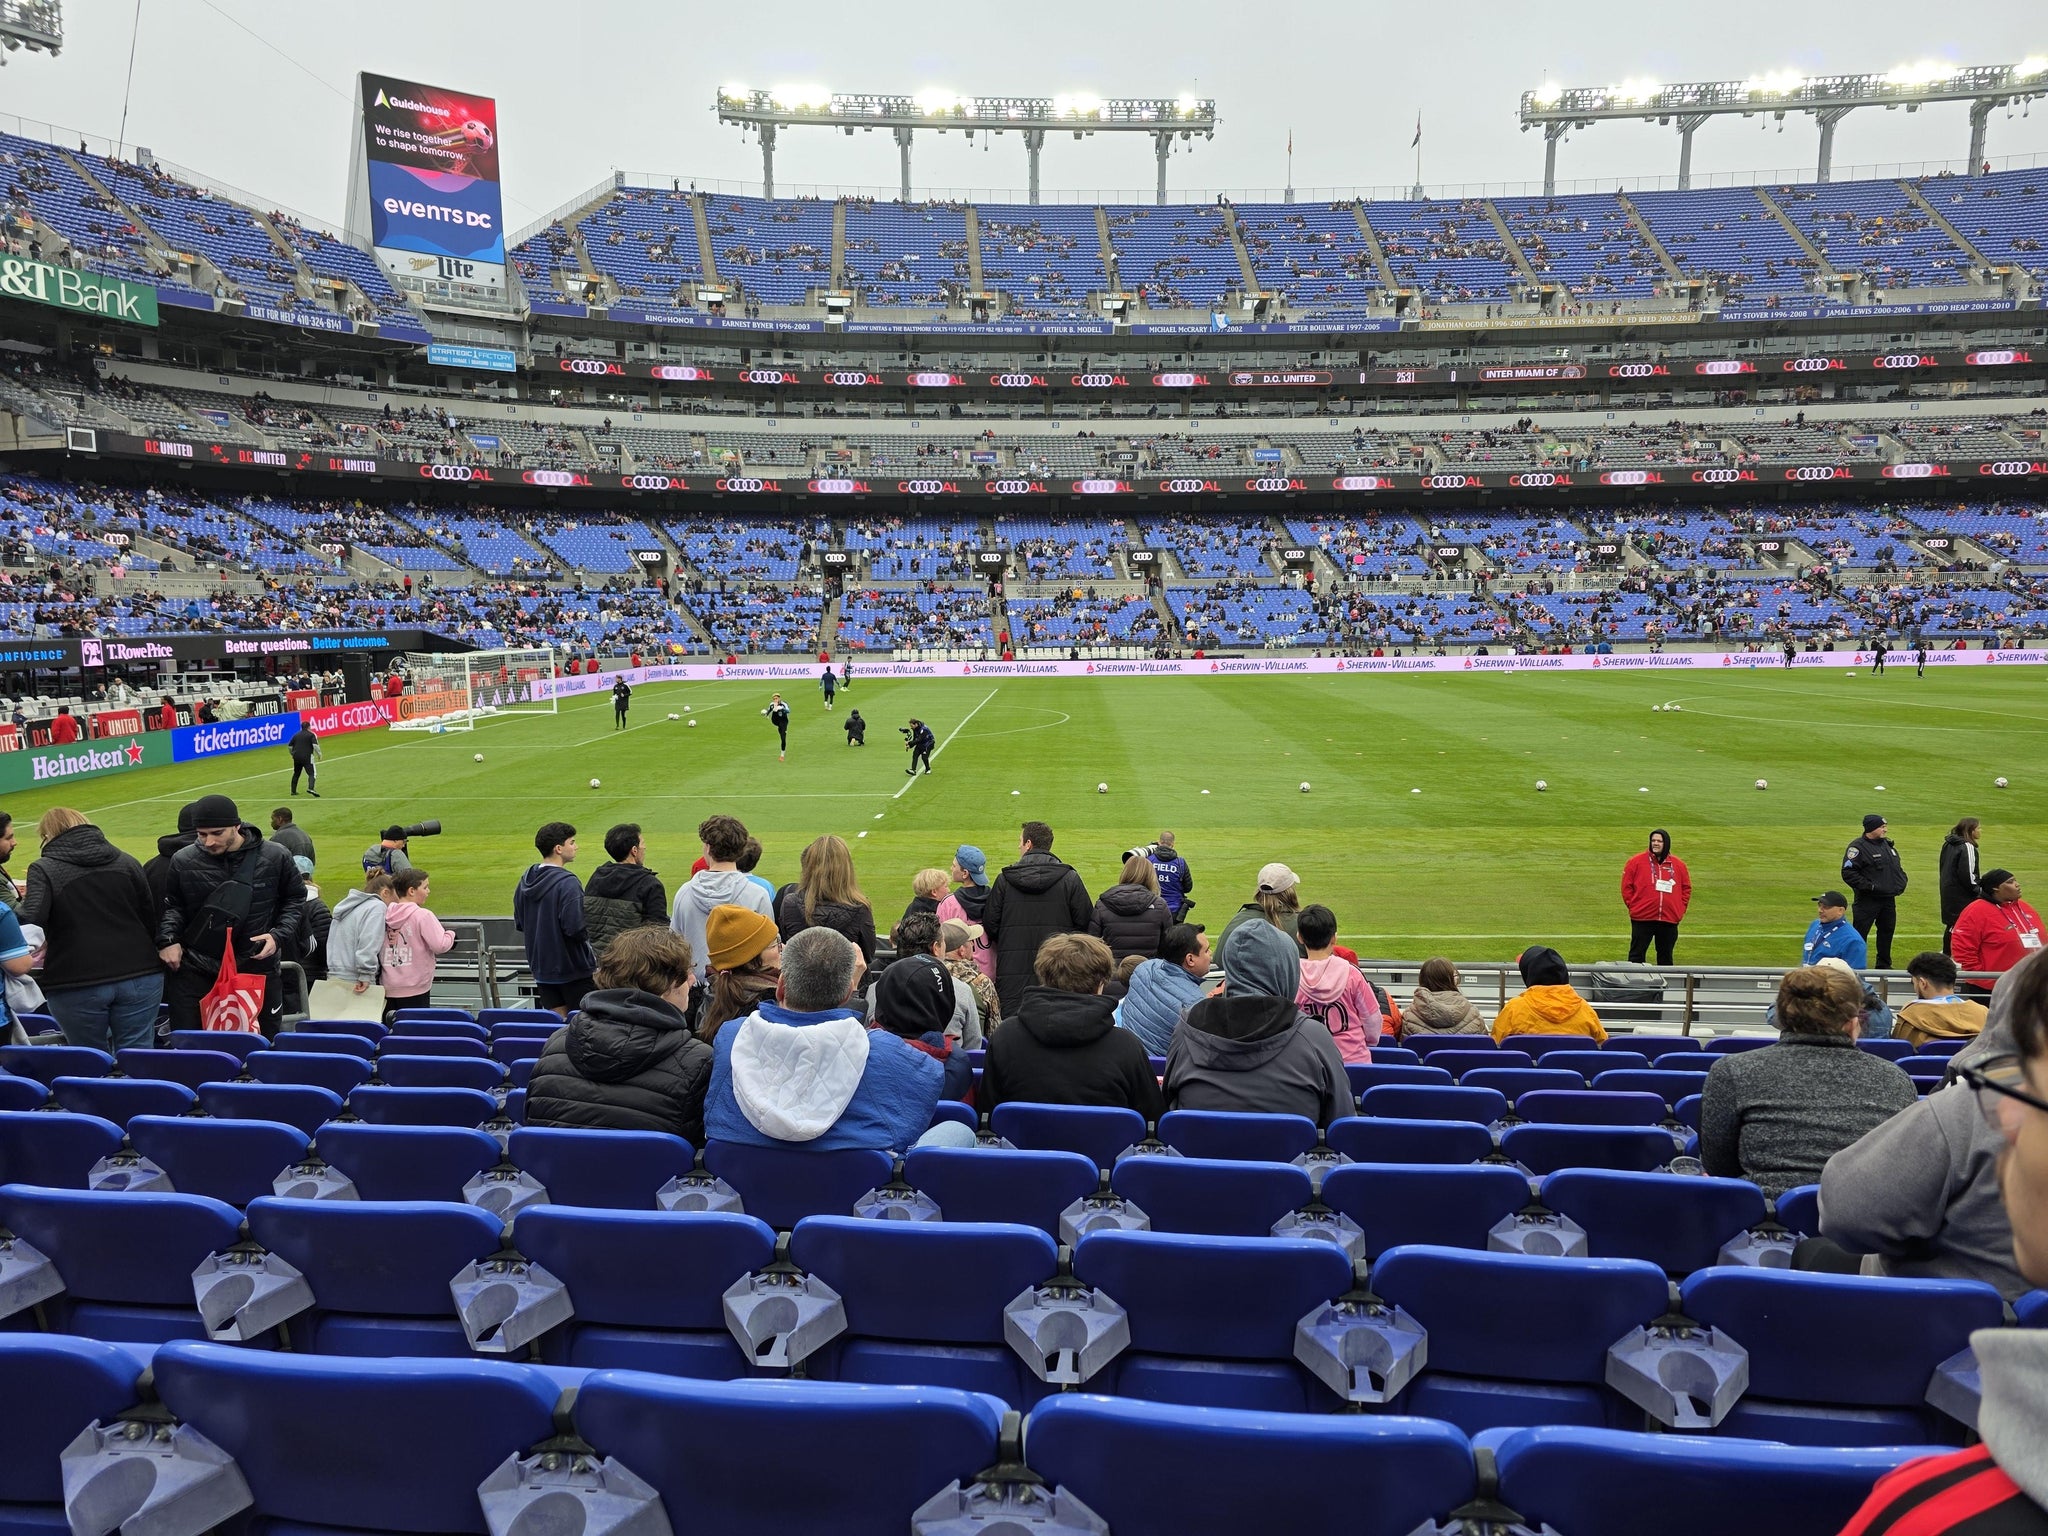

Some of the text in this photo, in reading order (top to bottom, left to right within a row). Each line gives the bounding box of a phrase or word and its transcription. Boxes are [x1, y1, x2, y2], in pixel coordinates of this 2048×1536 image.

[390, 96, 449, 117] Guidehouse
[375, 124, 452, 147] We rise together
[376, 136, 466, 162] to shape tomorrow.
[466, 211, 492, 229] DC
[436, 256, 474, 280] Lite
[0, 259, 141, 320] &T Bank
[1826, 306, 1912, 316] JAMAL LEWIS 2000-2006
[1928, 302, 2010, 312] TODD HEAP 2001-2010
[250, 306, 264, 318] TEXT
[266, 308, 278, 320] FOR
[280, 310, 296, 323] HELP
[645, 314, 662, 322] RING
[667, 315, 694, 324] HONOR
[1658, 314, 1696, 322] 2002-2012
[1722, 312, 1741, 320] MATT
[722, 320, 750, 329] EARNEST
[752, 320, 774, 330] BYNER
[1288, 324, 1308, 332] PETER
[1310, 324, 1344, 332] BOULWARE
[1465, 320, 1490, 328] OGDEN
[1539, 318, 1553, 326] RAY
[1554, 318, 1576, 326] LEWIS
[1077, 326, 1102, 334] MODELL
[1149, 326, 1176, 334] MICHAEL
[1178, 326, 1208, 334] McCRARY
[478, 351, 511, 360] FACTORY
[1264, 374, 1316, 383] D.C. UNITED
[1360, 372, 1365, 384] 0
[1450, 371, 1456, 382] 0
[1486, 368, 1558, 378] INTER MIAMI CF
[160, 442, 192, 457] UNITED
[254, 452, 286, 466] UNITED
[344, 460, 376, 472] UNITED
[226, 638, 310, 655] Better questions.
[312, 636, 389, 650] Better outcomes.
[108, 718, 138, 736] UNITED
[309, 712, 338, 732] Audi
[193, 721, 285, 755] ticketmaster
[32, 748, 124, 782] Heineken
[1152, 862, 1178, 874] FIELD
[1158, 874, 1170, 883] 81
